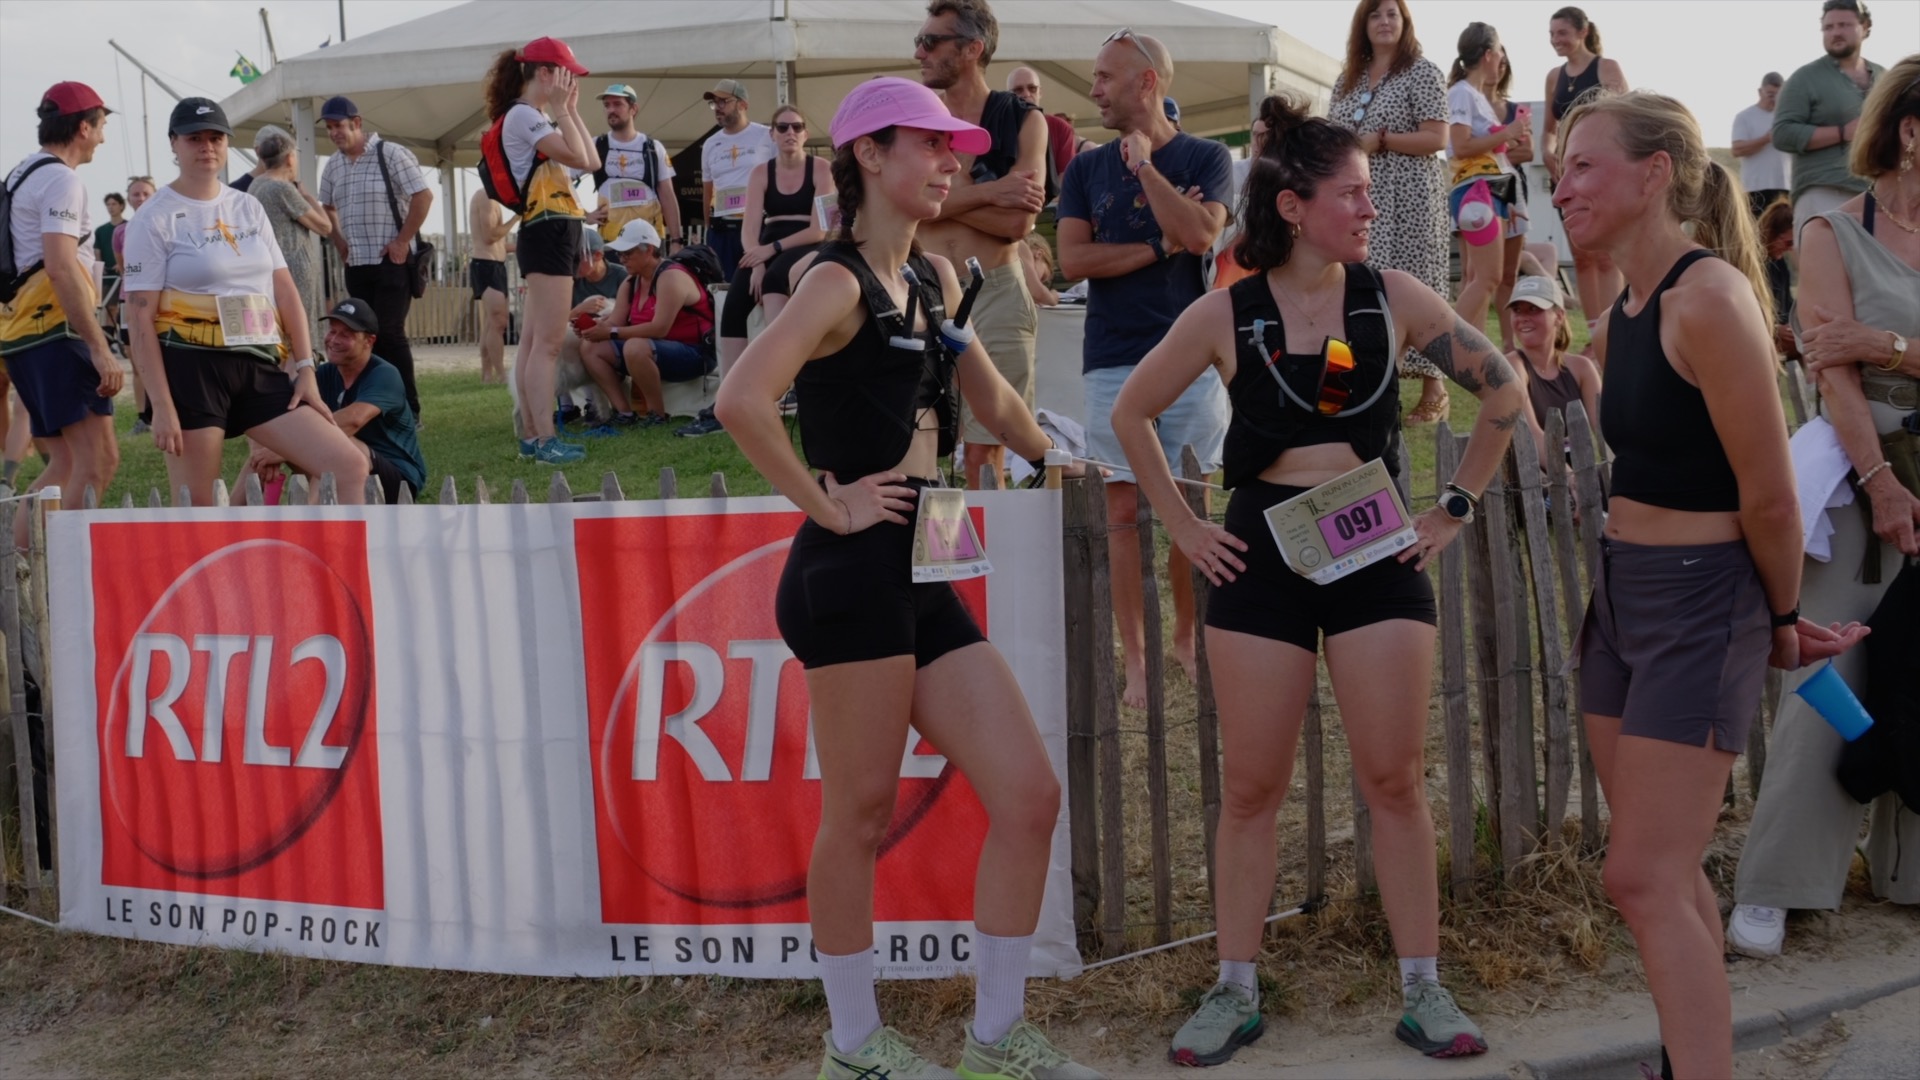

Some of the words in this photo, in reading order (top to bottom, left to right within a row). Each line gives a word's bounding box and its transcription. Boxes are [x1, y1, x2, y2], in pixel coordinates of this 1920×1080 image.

[627, 189, 640, 197] 147
[730, 197, 740, 205] 117
[1322, 485, 1342, 498] RUN
[1341, 480, 1352, 490] IN
[1353, 468, 1378, 485] LAND
[1334, 500, 1383, 541] 097
[125, 633, 348, 769] RTL2
[106, 897, 133, 923] LE
[149, 901, 204, 930] SON
[221, 908, 381, 947] POP-ROCK
[610, 935, 650, 962] LE
[674, 936, 754, 964] SON
